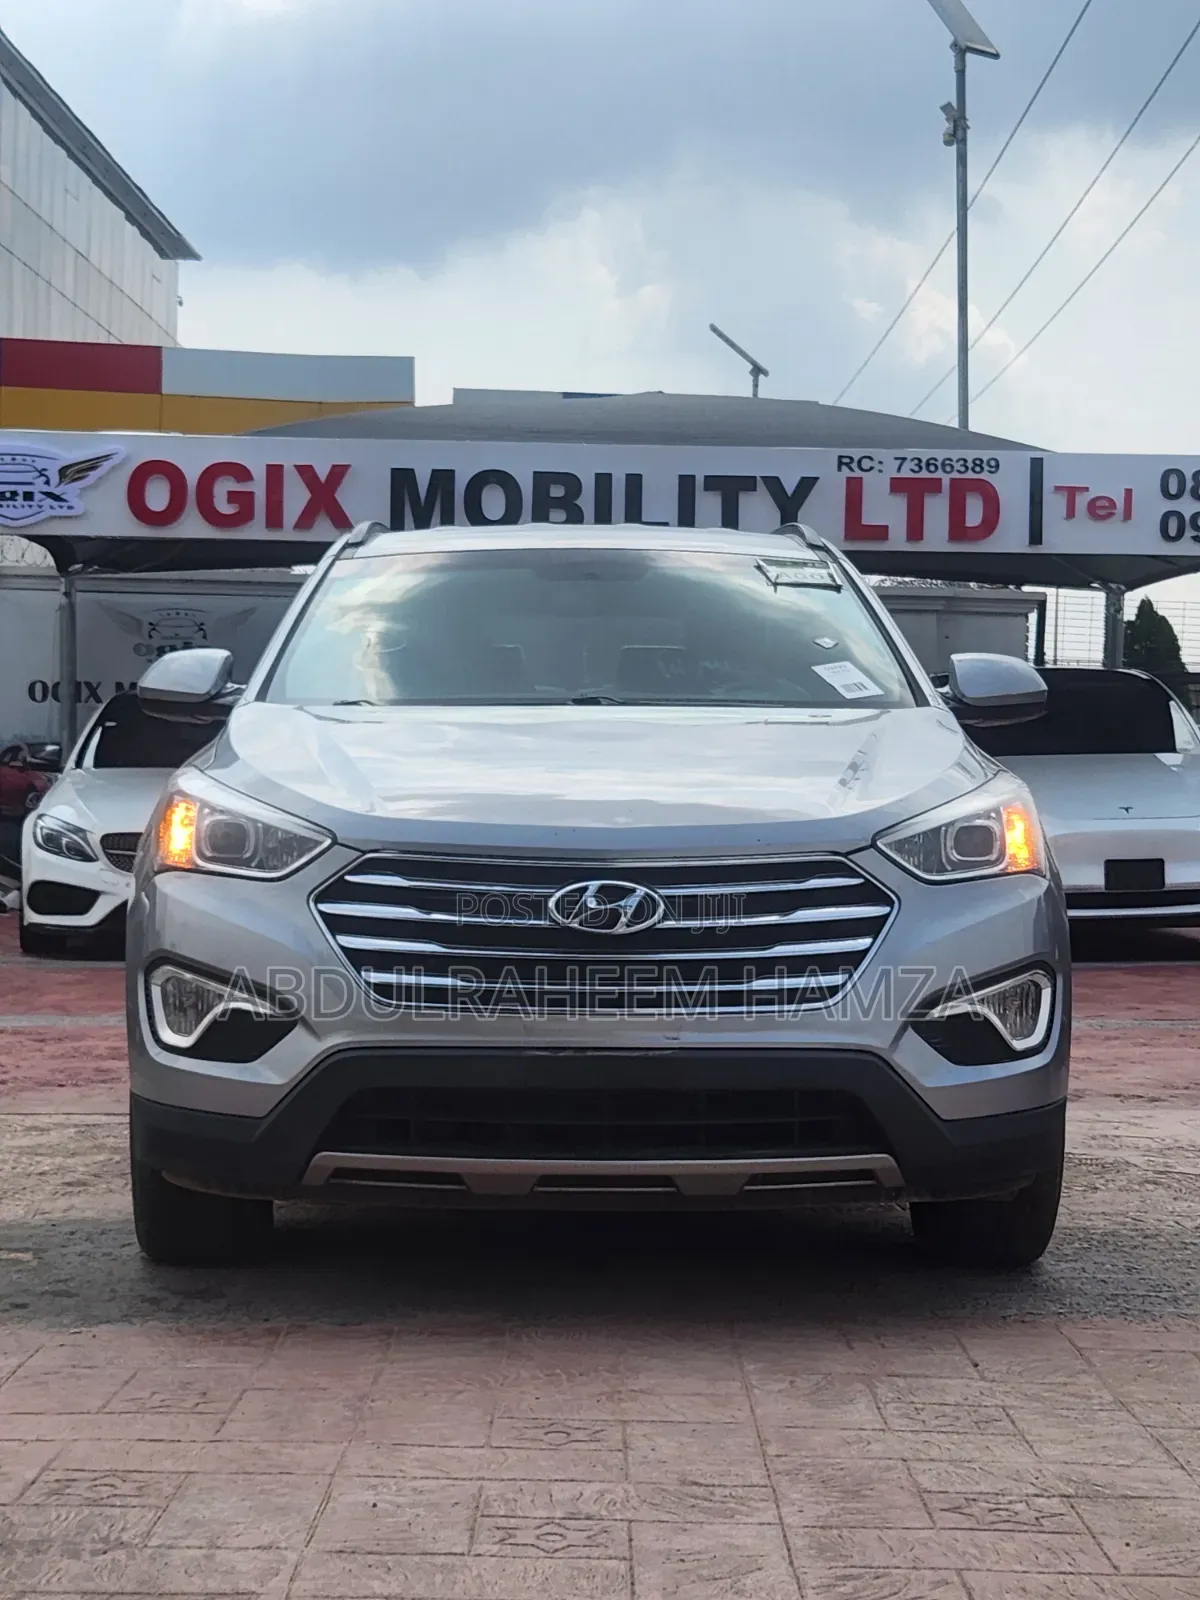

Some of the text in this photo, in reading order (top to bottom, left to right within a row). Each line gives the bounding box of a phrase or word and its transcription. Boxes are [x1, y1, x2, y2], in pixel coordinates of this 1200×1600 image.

[837, 454, 1000, 475] RC: 7366389
[126, 459, 1000, 542] OGIX MOBILITY LTD
[1053, 485, 1133, 522] Tel
